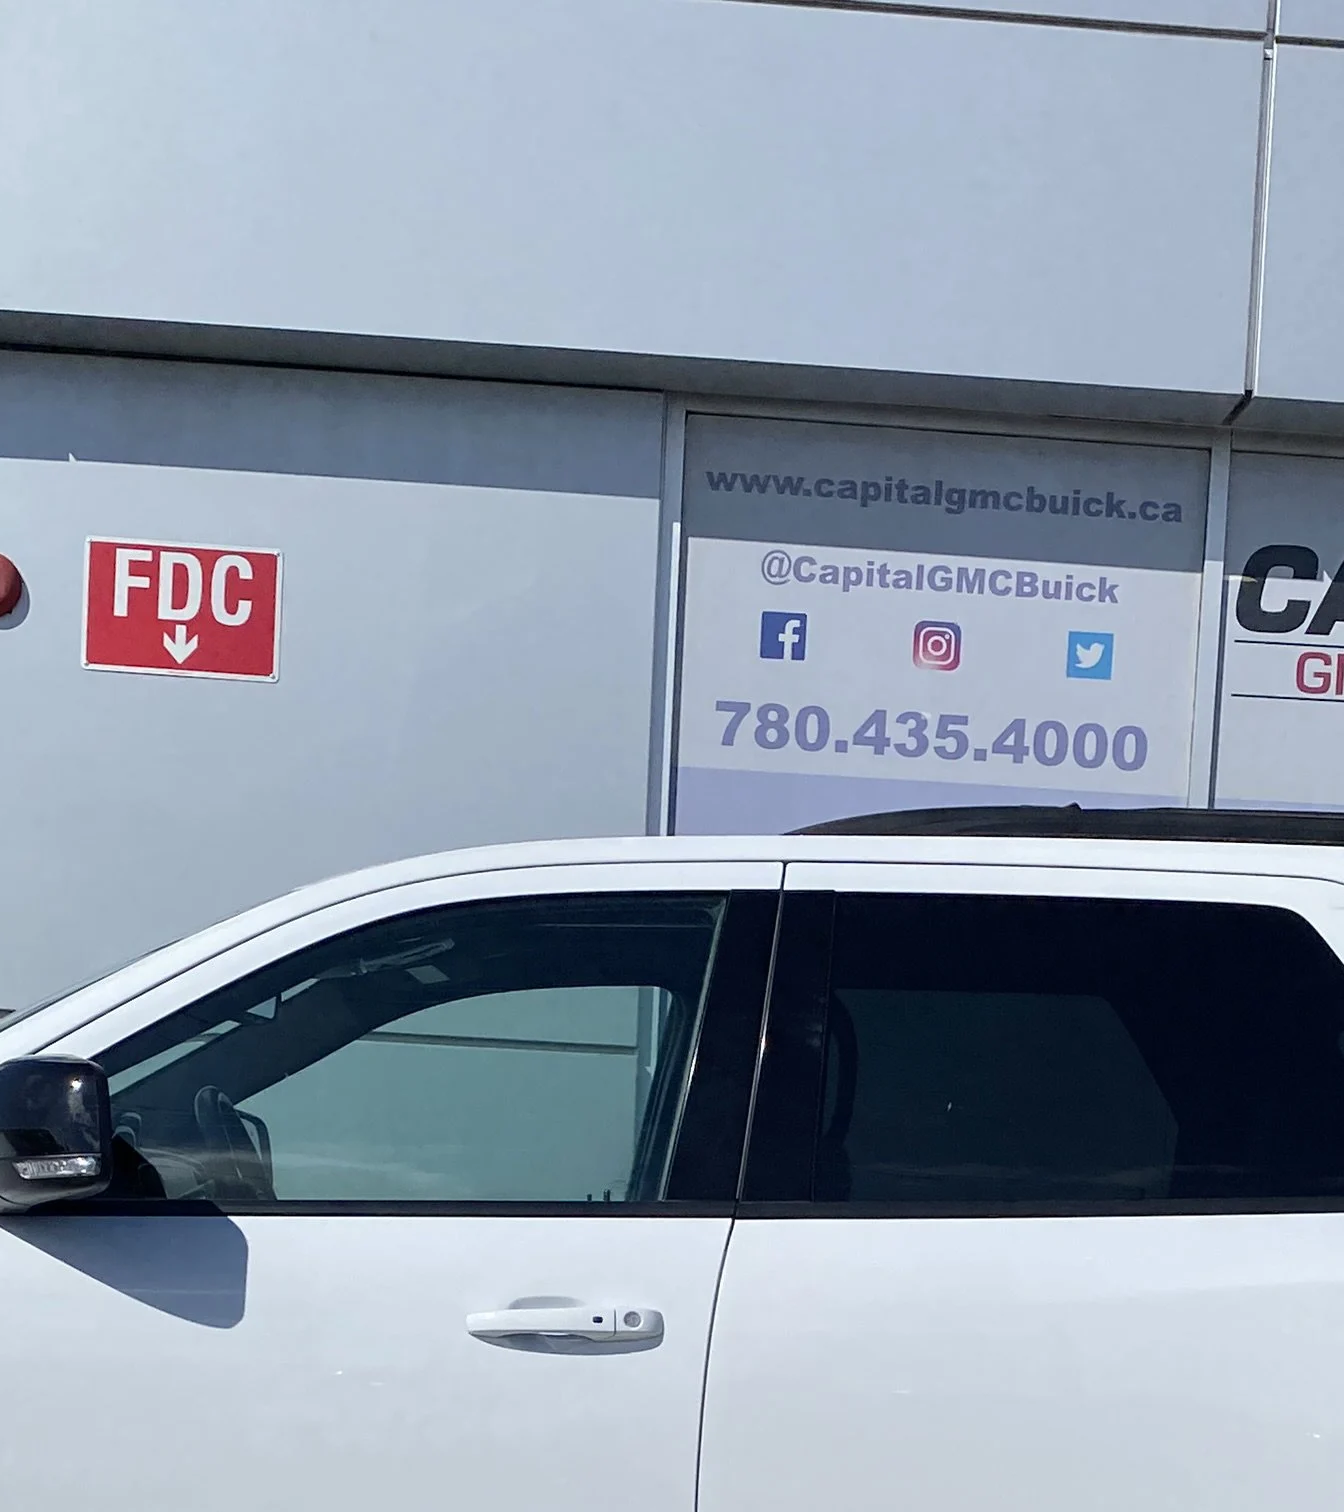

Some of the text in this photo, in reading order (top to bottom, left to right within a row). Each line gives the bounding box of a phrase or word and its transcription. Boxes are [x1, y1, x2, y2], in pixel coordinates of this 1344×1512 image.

[706, 470, 1183, 524] www.capitalgmcbuick.ca
[112, 548, 254, 627] FDC
[760, 549, 1120, 604] @CapitalGMCBuick
[714, 700, 1148, 772] 780.435.4000
